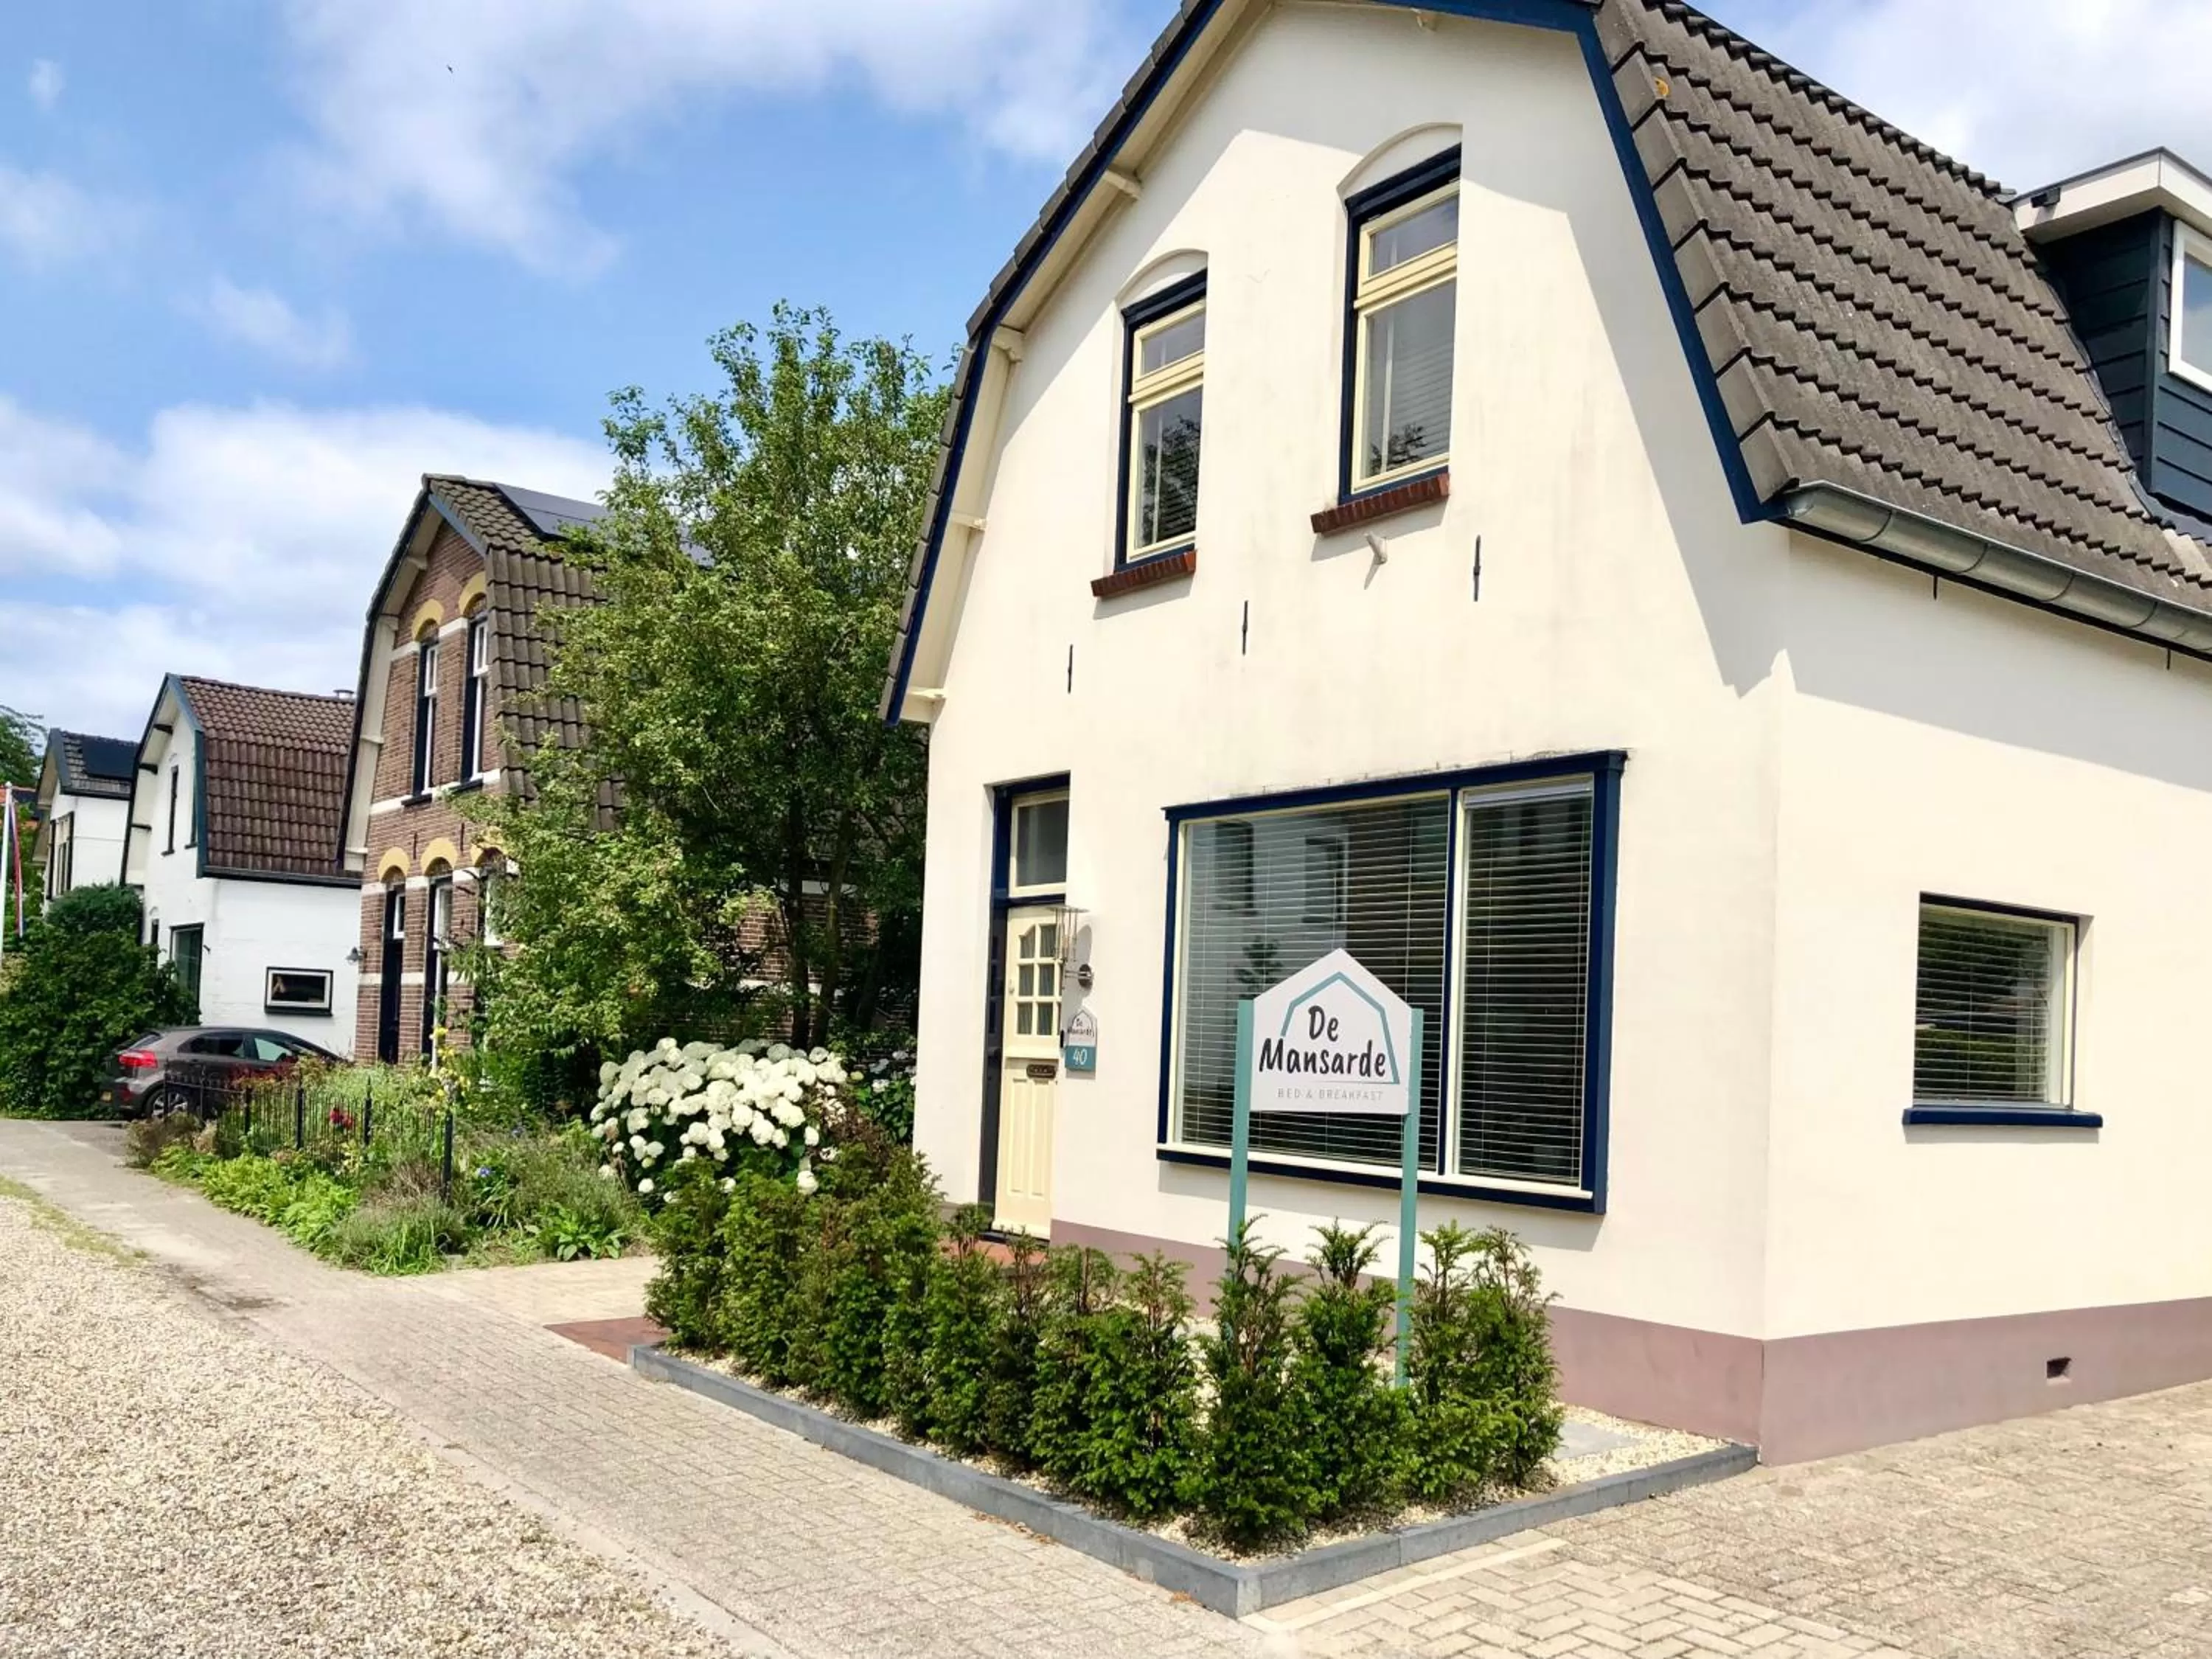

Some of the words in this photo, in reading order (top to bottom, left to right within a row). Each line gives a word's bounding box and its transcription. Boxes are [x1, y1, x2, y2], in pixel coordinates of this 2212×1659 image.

[1308, 1005, 1339, 1042] De
[1073, 1048, 1088, 1065] 40
[1259, 1037, 1386, 1077] Mansarde
[1278, 1088, 1301, 1099] BED
